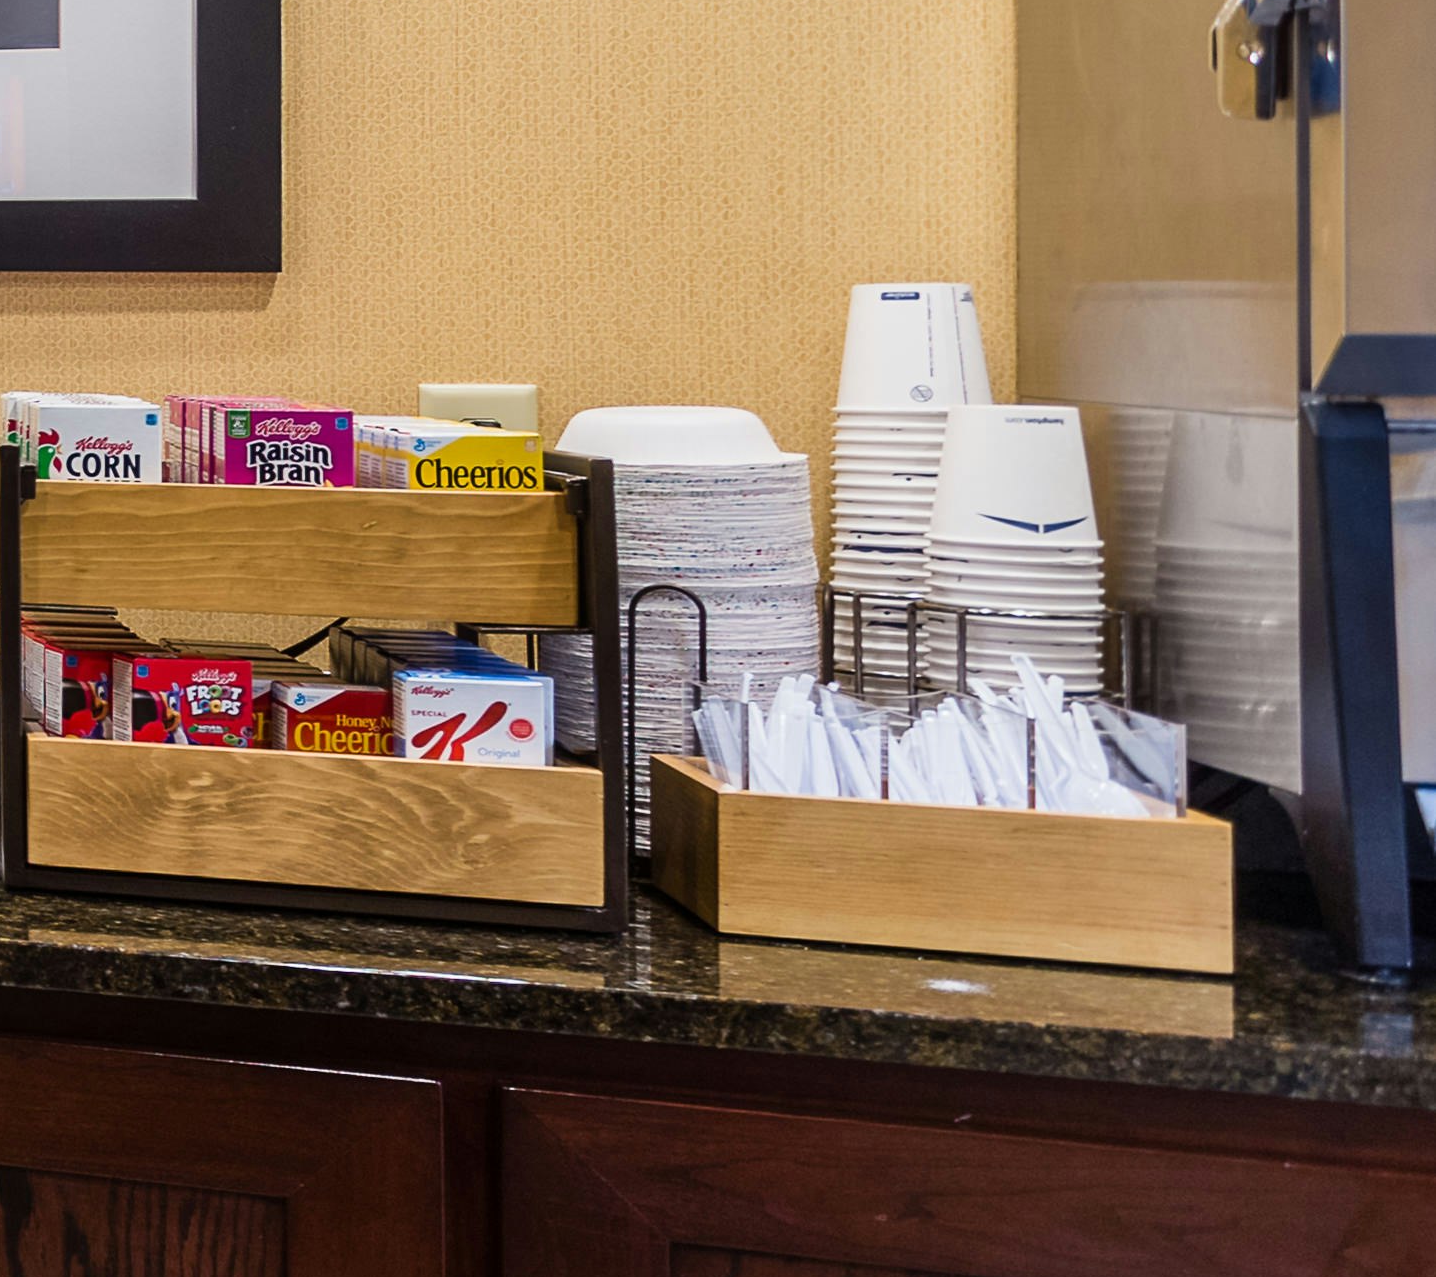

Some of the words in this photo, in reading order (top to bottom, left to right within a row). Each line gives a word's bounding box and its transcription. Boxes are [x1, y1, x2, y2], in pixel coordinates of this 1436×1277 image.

[255, 417, 321, 439] Kellogg's
[75, 436, 134, 455] Kellogg's
[248, 440, 332, 468] Raisin
[66, 452, 141, 479] CORN
[258, 463, 324, 486] Bran
[415, 458, 538, 489] Cheerios
[186, 685, 242, 702] FROOT
[191, 699, 242, 716] LOOPS
[411, 709, 447, 718] SPECIAL
[336, 714, 378, 730] Honey
[411, 701, 508, 761] K
[294, 722, 394, 755] Cheerio
[477, 746, 521, 759] Original
